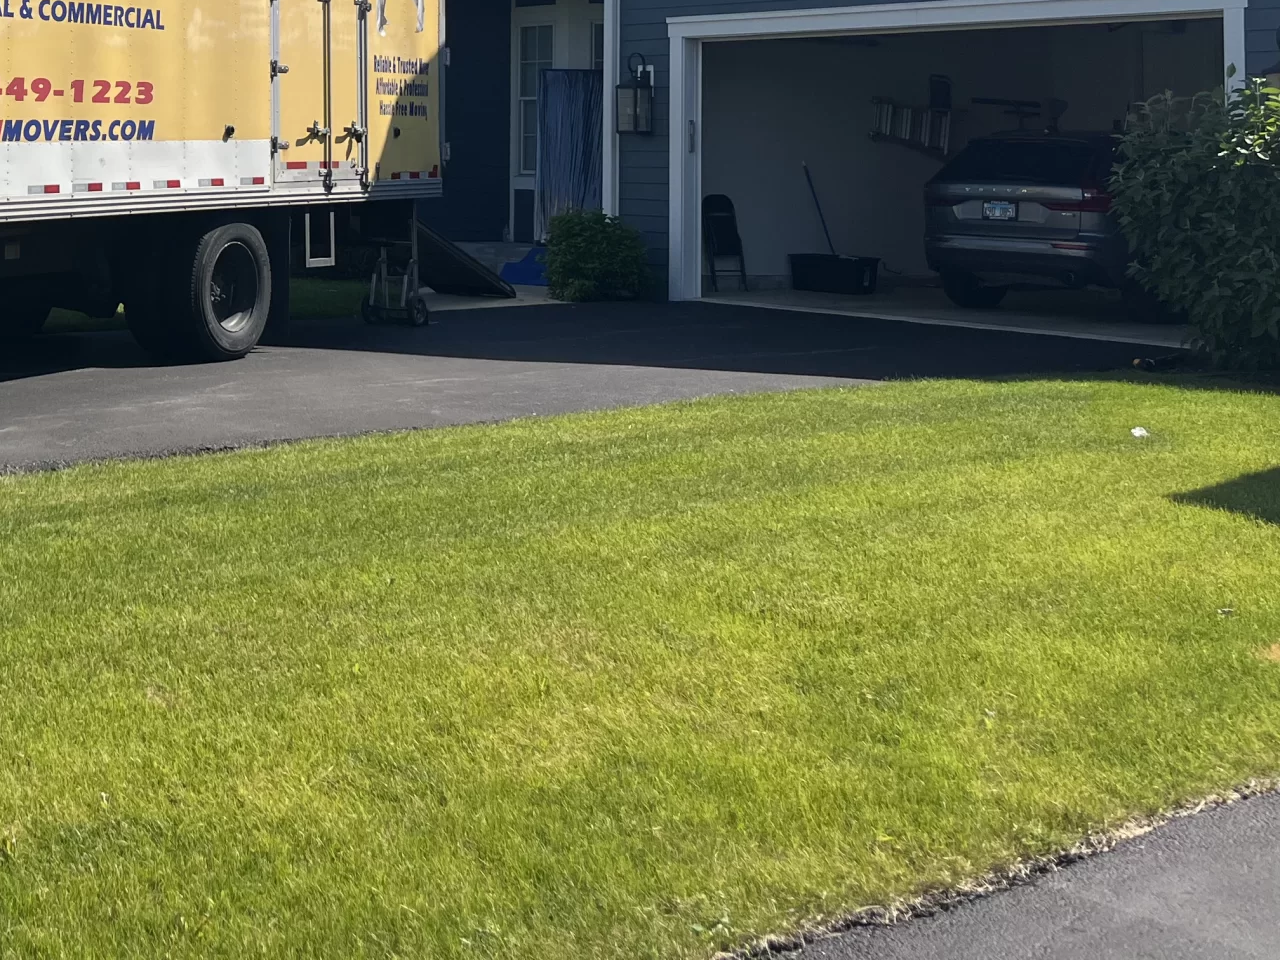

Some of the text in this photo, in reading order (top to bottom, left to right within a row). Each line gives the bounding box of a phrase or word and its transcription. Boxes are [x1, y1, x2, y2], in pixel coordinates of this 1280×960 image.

[397, 56, 418, 75] Trusted
[395, 100, 408, 117] Free
[409, 100, 428, 122] Moving
